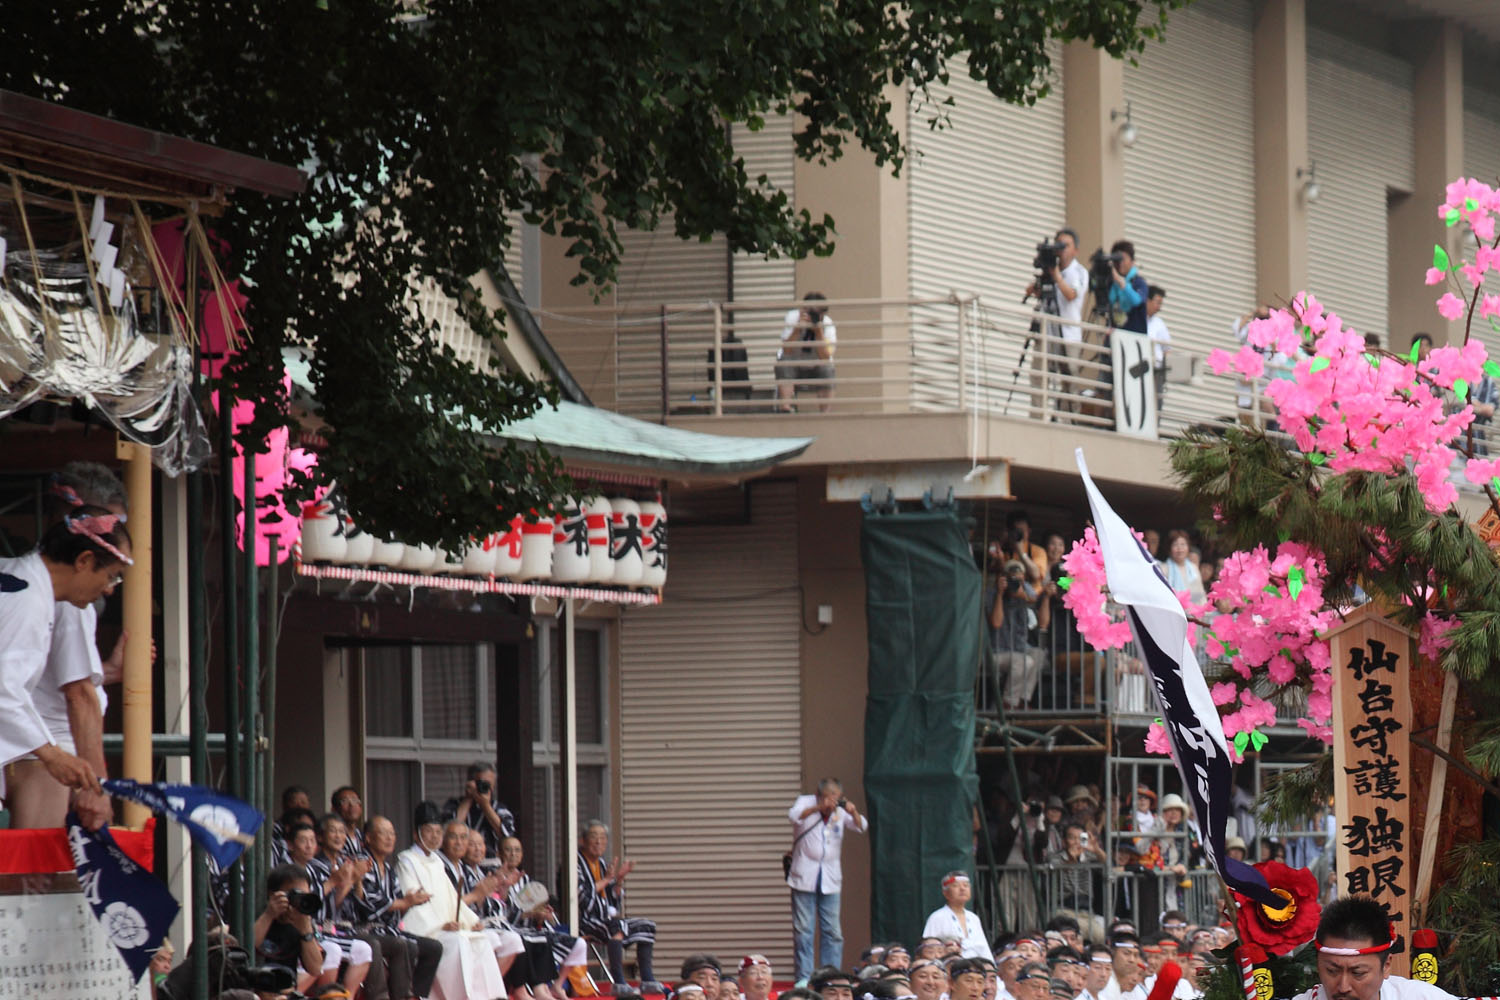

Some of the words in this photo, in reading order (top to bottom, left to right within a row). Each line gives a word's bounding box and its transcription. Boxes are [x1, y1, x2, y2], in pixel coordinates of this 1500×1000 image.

[1119, 339, 1150, 431] け
[1342, 638, 1407, 954] 仙台守護独眼
